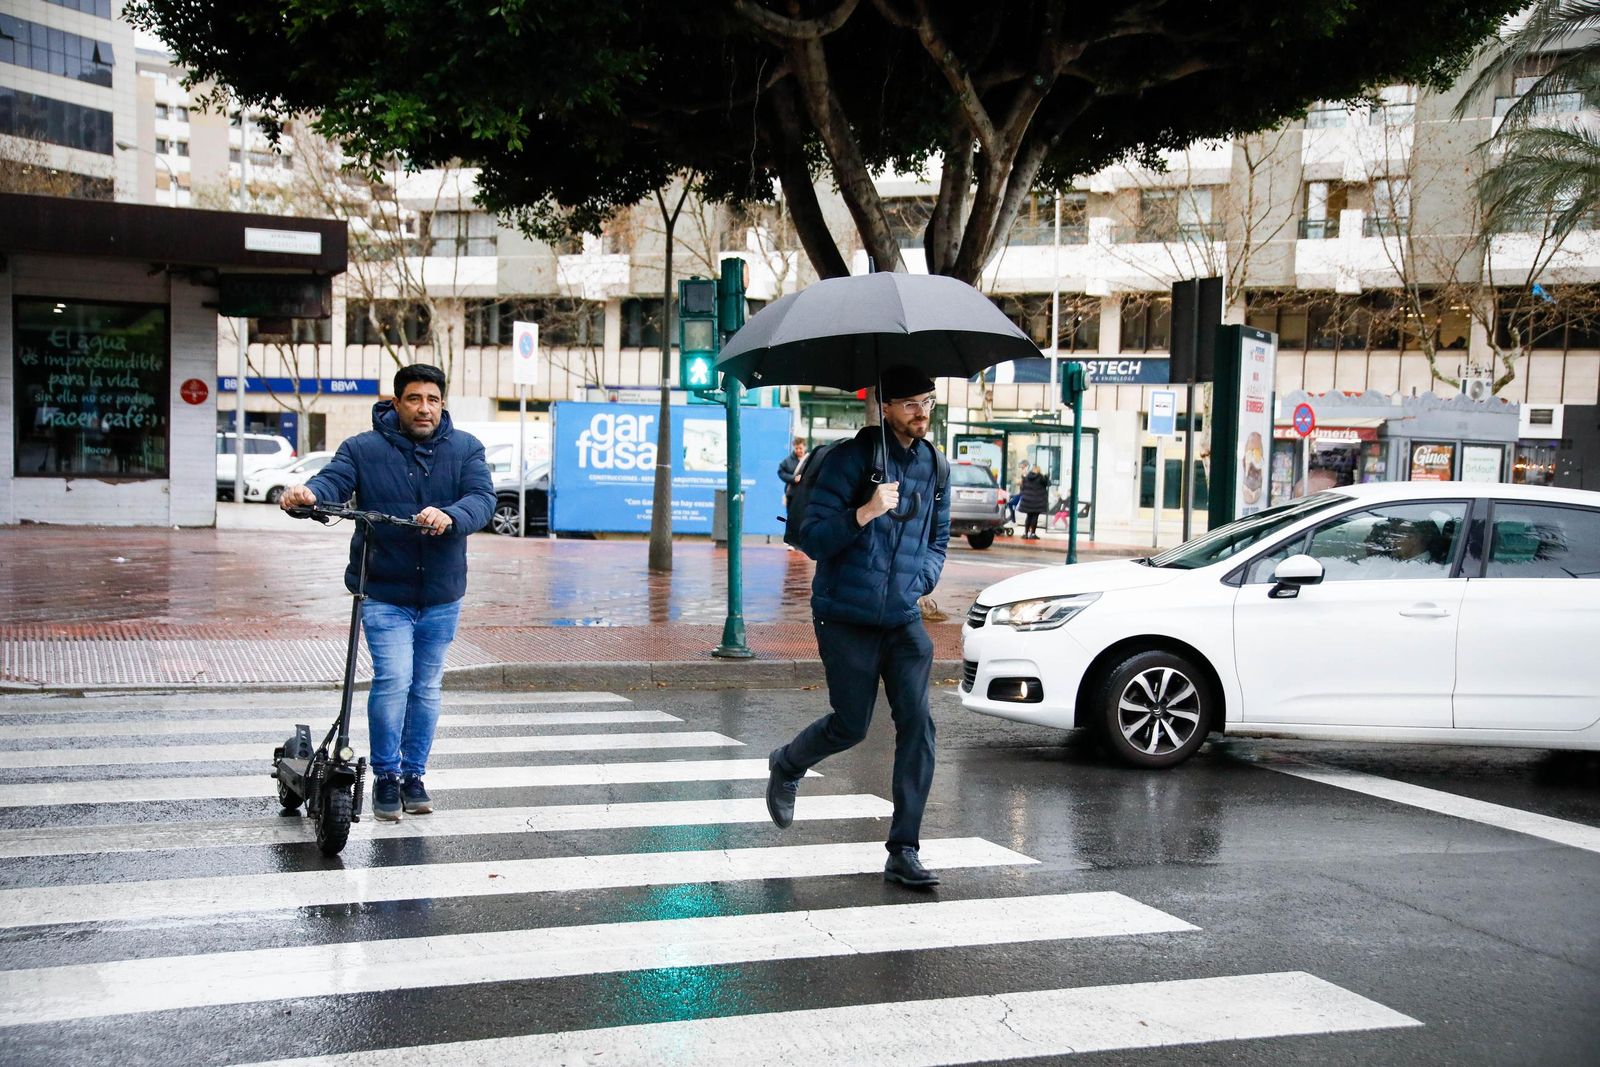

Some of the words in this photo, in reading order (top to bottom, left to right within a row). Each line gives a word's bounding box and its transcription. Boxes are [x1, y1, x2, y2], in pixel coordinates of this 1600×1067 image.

[48, 328, 71, 348] El
[77, 335, 127, 352] agua
[44, 352, 162, 373] imprescindible
[48, 373, 85, 392] para
[90, 369, 103, 387] la
[107, 369, 139, 388] vida
[224, 378, 250, 390] BBA
[331, 381, 358, 391] BBVA
[57, 390, 77, 403] ella
[42, 402, 98, 427] hacer
[590, 412, 653, 450] gar
[576, 429, 658, 470] fusa
[1413, 445, 1450, 465] Ginos
